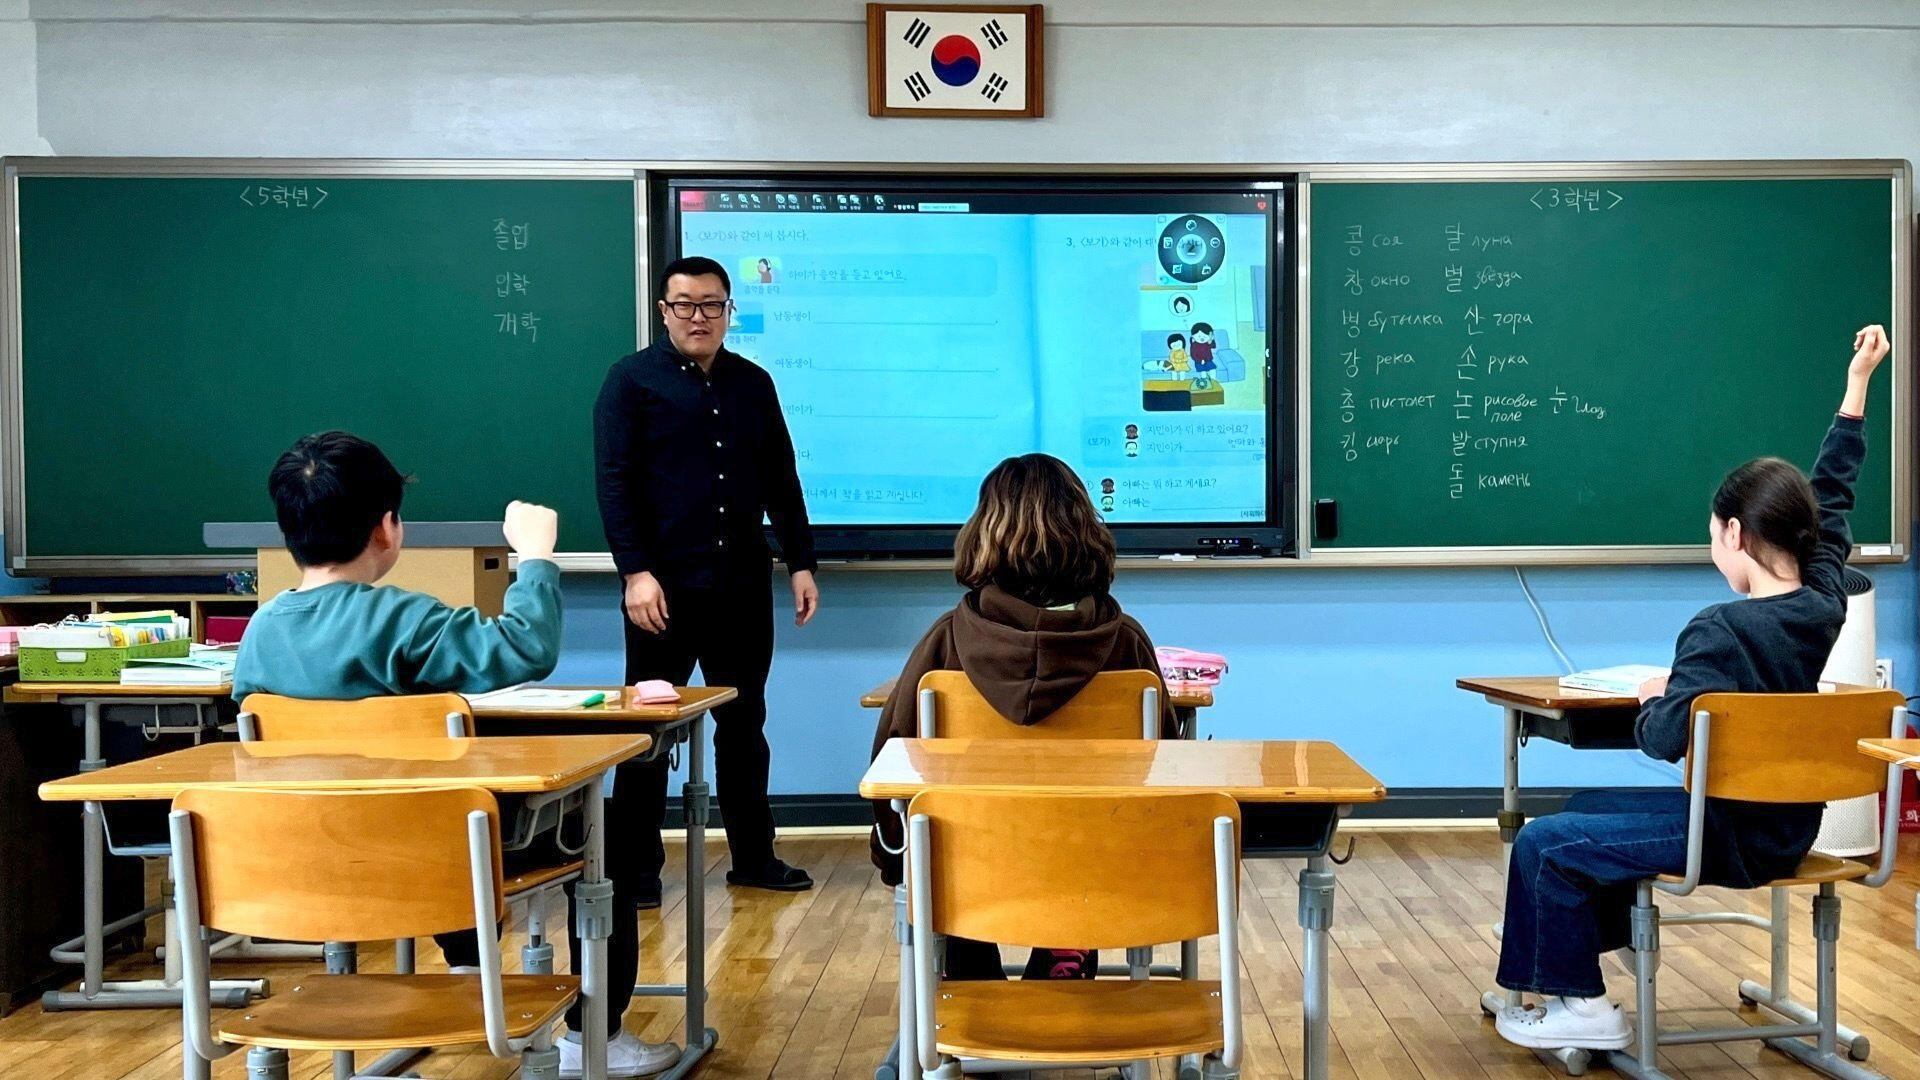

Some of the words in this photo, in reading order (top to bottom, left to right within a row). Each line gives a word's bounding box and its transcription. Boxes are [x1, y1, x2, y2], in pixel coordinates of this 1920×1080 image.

[240, 185, 328, 209] <5학년>
[1530, 188, 1623, 213] <3학년>
[493, 217, 530, 251] 졸업
[1344, 224, 1364, 256] 콩
[1445, 222, 1465, 252] 달
[1471, 235, 1512, 251] луна
[496, 271, 531, 298] 입학
[1344, 267, 1363, 295] 창
[1371, 275, 1410, 287] окно
[1445, 264, 1463, 293] 별
[494, 311, 541, 343] 개학
[774, 310, 811, 322] 남동생이
[1342, 308, 1361, 338] 병
[1368, 310, 1443, 334] бутылка
[1464, 303, 1486, 336] 산
[1493, 313, 1534, 335] гора
[775, 357, 812, 370] 여동생이
[1340, 348, 1361, 378] 강
[1375, 352, 1416, 375] река
[1456, 344, 1478, 380] 손
[1487, 354, 1529, 374] рука
[1340, 387, 1356, 423] 총
[1369, 394, 1436, 410] пистолет
[1452, 390, 1474, 420] 논
[1484, 393, 1538, 417] рисовое
[1549, 385, 1569, 414] 눈
[1490, 410, 1523, 424] поле
[1340, 431, 1358, 461] 킹
[1452, 430, 1472, 457] 발
[1474, 435, 1529, 453] ступня
[1449, 463, 1465, 499] 돌
[1478, 472, 1531, 490] камень
